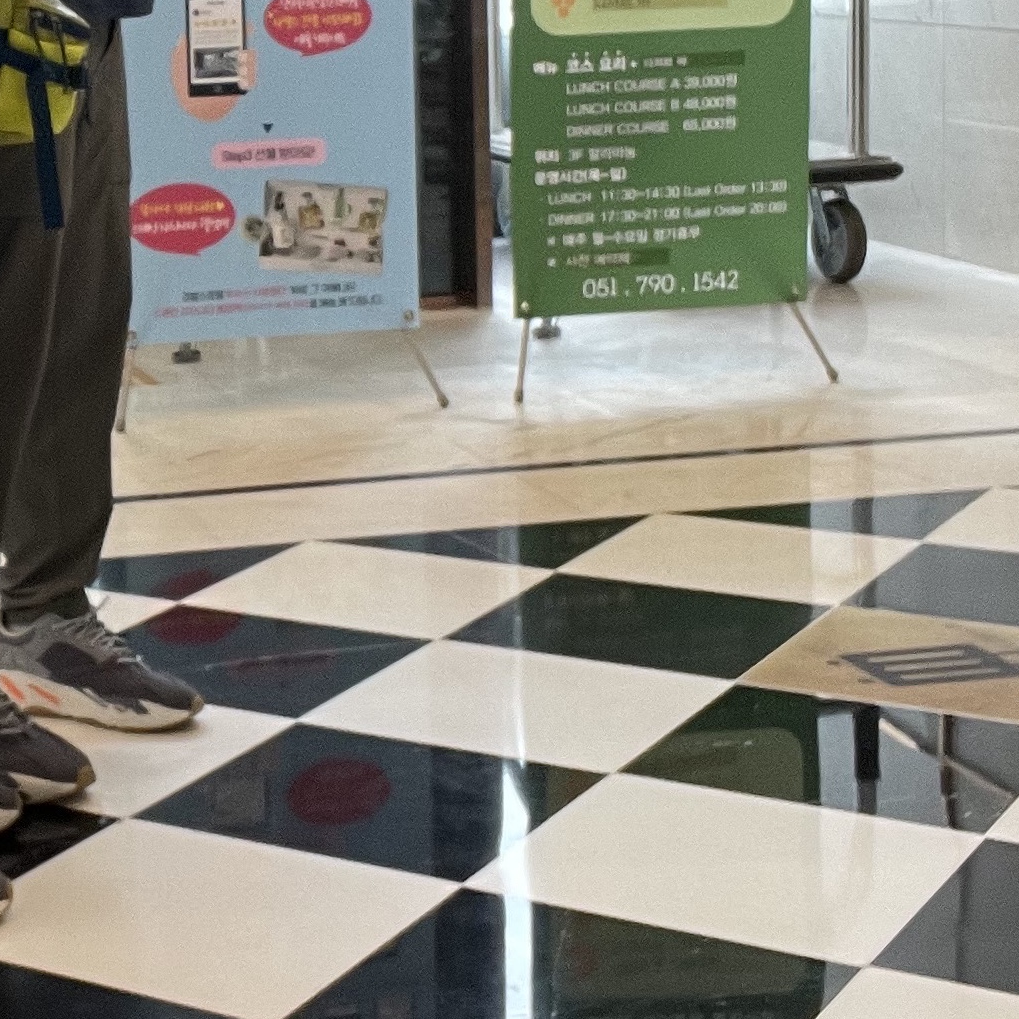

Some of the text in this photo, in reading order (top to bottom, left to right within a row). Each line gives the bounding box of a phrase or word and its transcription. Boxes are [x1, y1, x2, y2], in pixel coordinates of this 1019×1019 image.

[566, 81, 610, 95] LUNCH
[614, 77, 667, 93] COURSE
[566, 102, 610, 116] LUNCH
[614, 99, 667, 113] COURSE
[566, 124, 613, 138] DINNER
[616, 120, 669, 136] COURSE
[547, 191, 592, 206] LUNCH
[547, 211, 595, 227] DINNER
[582, 277, 617, 299] 051
[635, 273, 675, 295] 790
[693, 270, 739, 292] 1542
